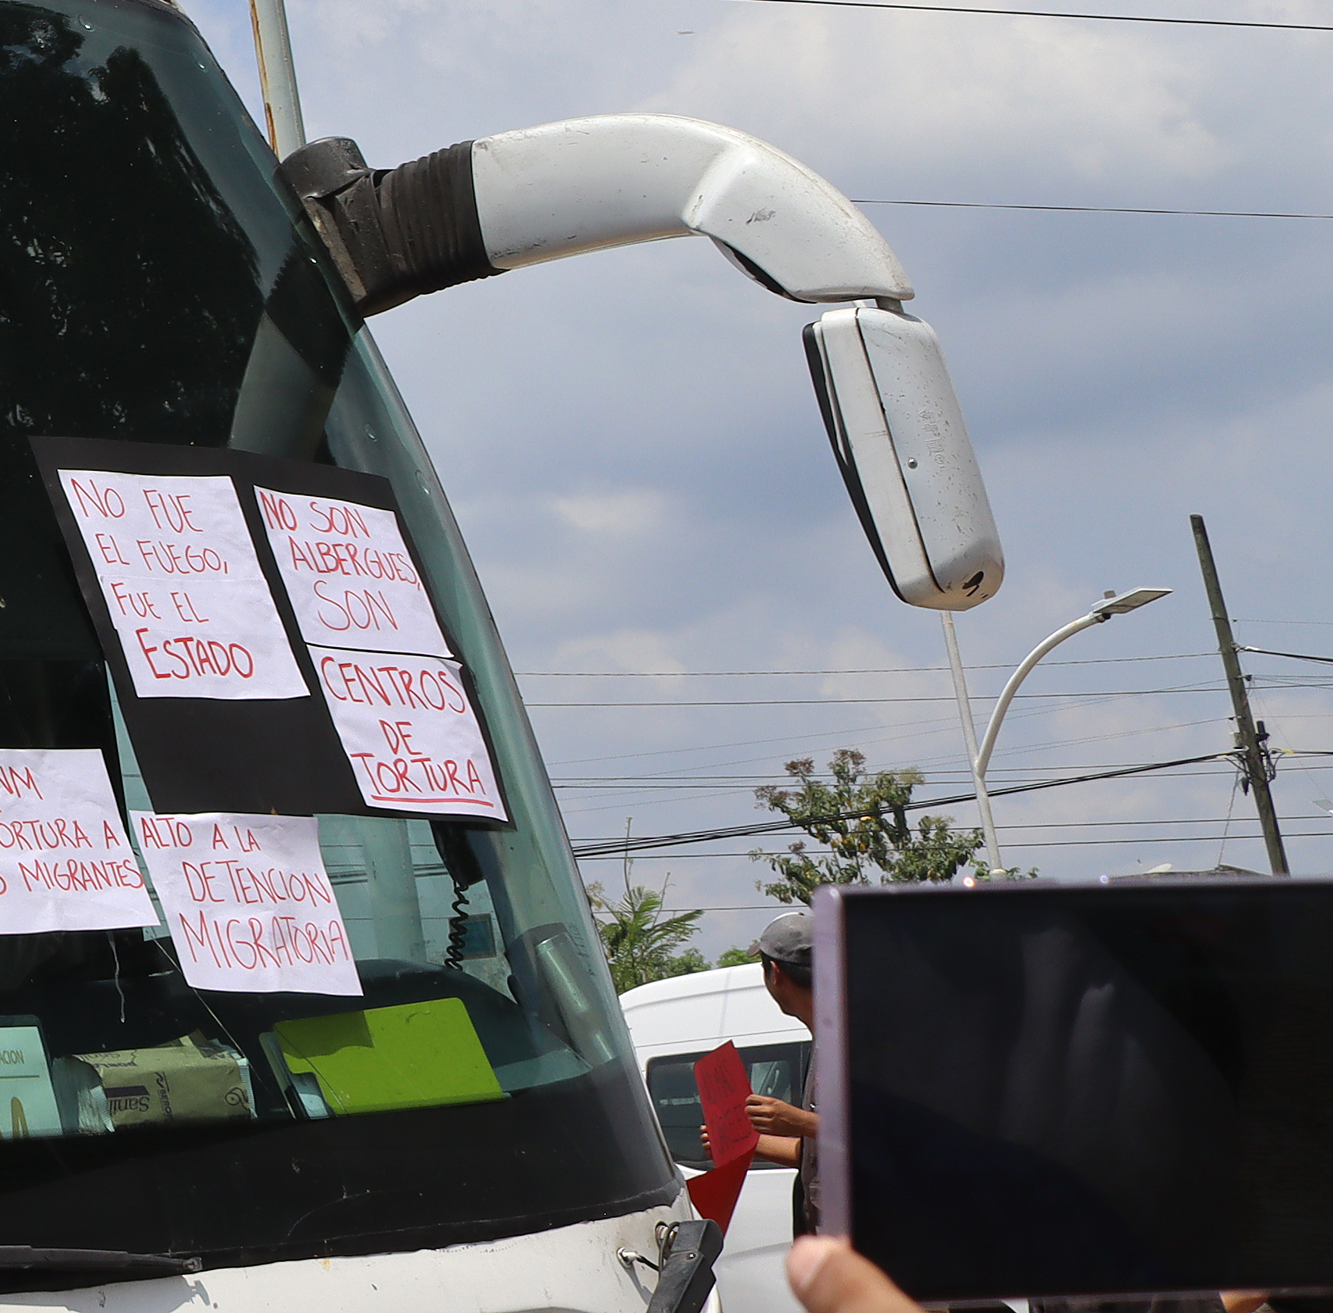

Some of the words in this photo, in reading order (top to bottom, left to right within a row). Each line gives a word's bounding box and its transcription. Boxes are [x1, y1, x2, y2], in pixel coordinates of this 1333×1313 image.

[71, 477, 125, 519] NO
[142, 489, 204, 534] FUE
[258, 490, 297, 532] NO
[308, 501, 372, 540] SON
[95, 533, 130, 566] EL
[136, 539, 229, 575] FUEGO,
[288, 535, 423, 591] ALBERGUES,
[110, 582, 162, 620] FUE
[170, 591, 209, 624] EL
[313, 579, 399, 632] SON
[135, 627, 254, 680] ESTADO
[320, 655, 467, 715] CENTROS
[379, 719, 422, 756] DE
[350, 752, 487, 797] TORTURA
[102, 819, 121, 850] A
[140, 817, 193, 849] ALTO
[212, 823, 229, 851] A
[234, 825, 262, 853] LA
[18, 858, 145, 892] MIGRANTES
[182, 859, 333, 907] DETENCION
[179, 909, 350, 970] MIGRATORIA
